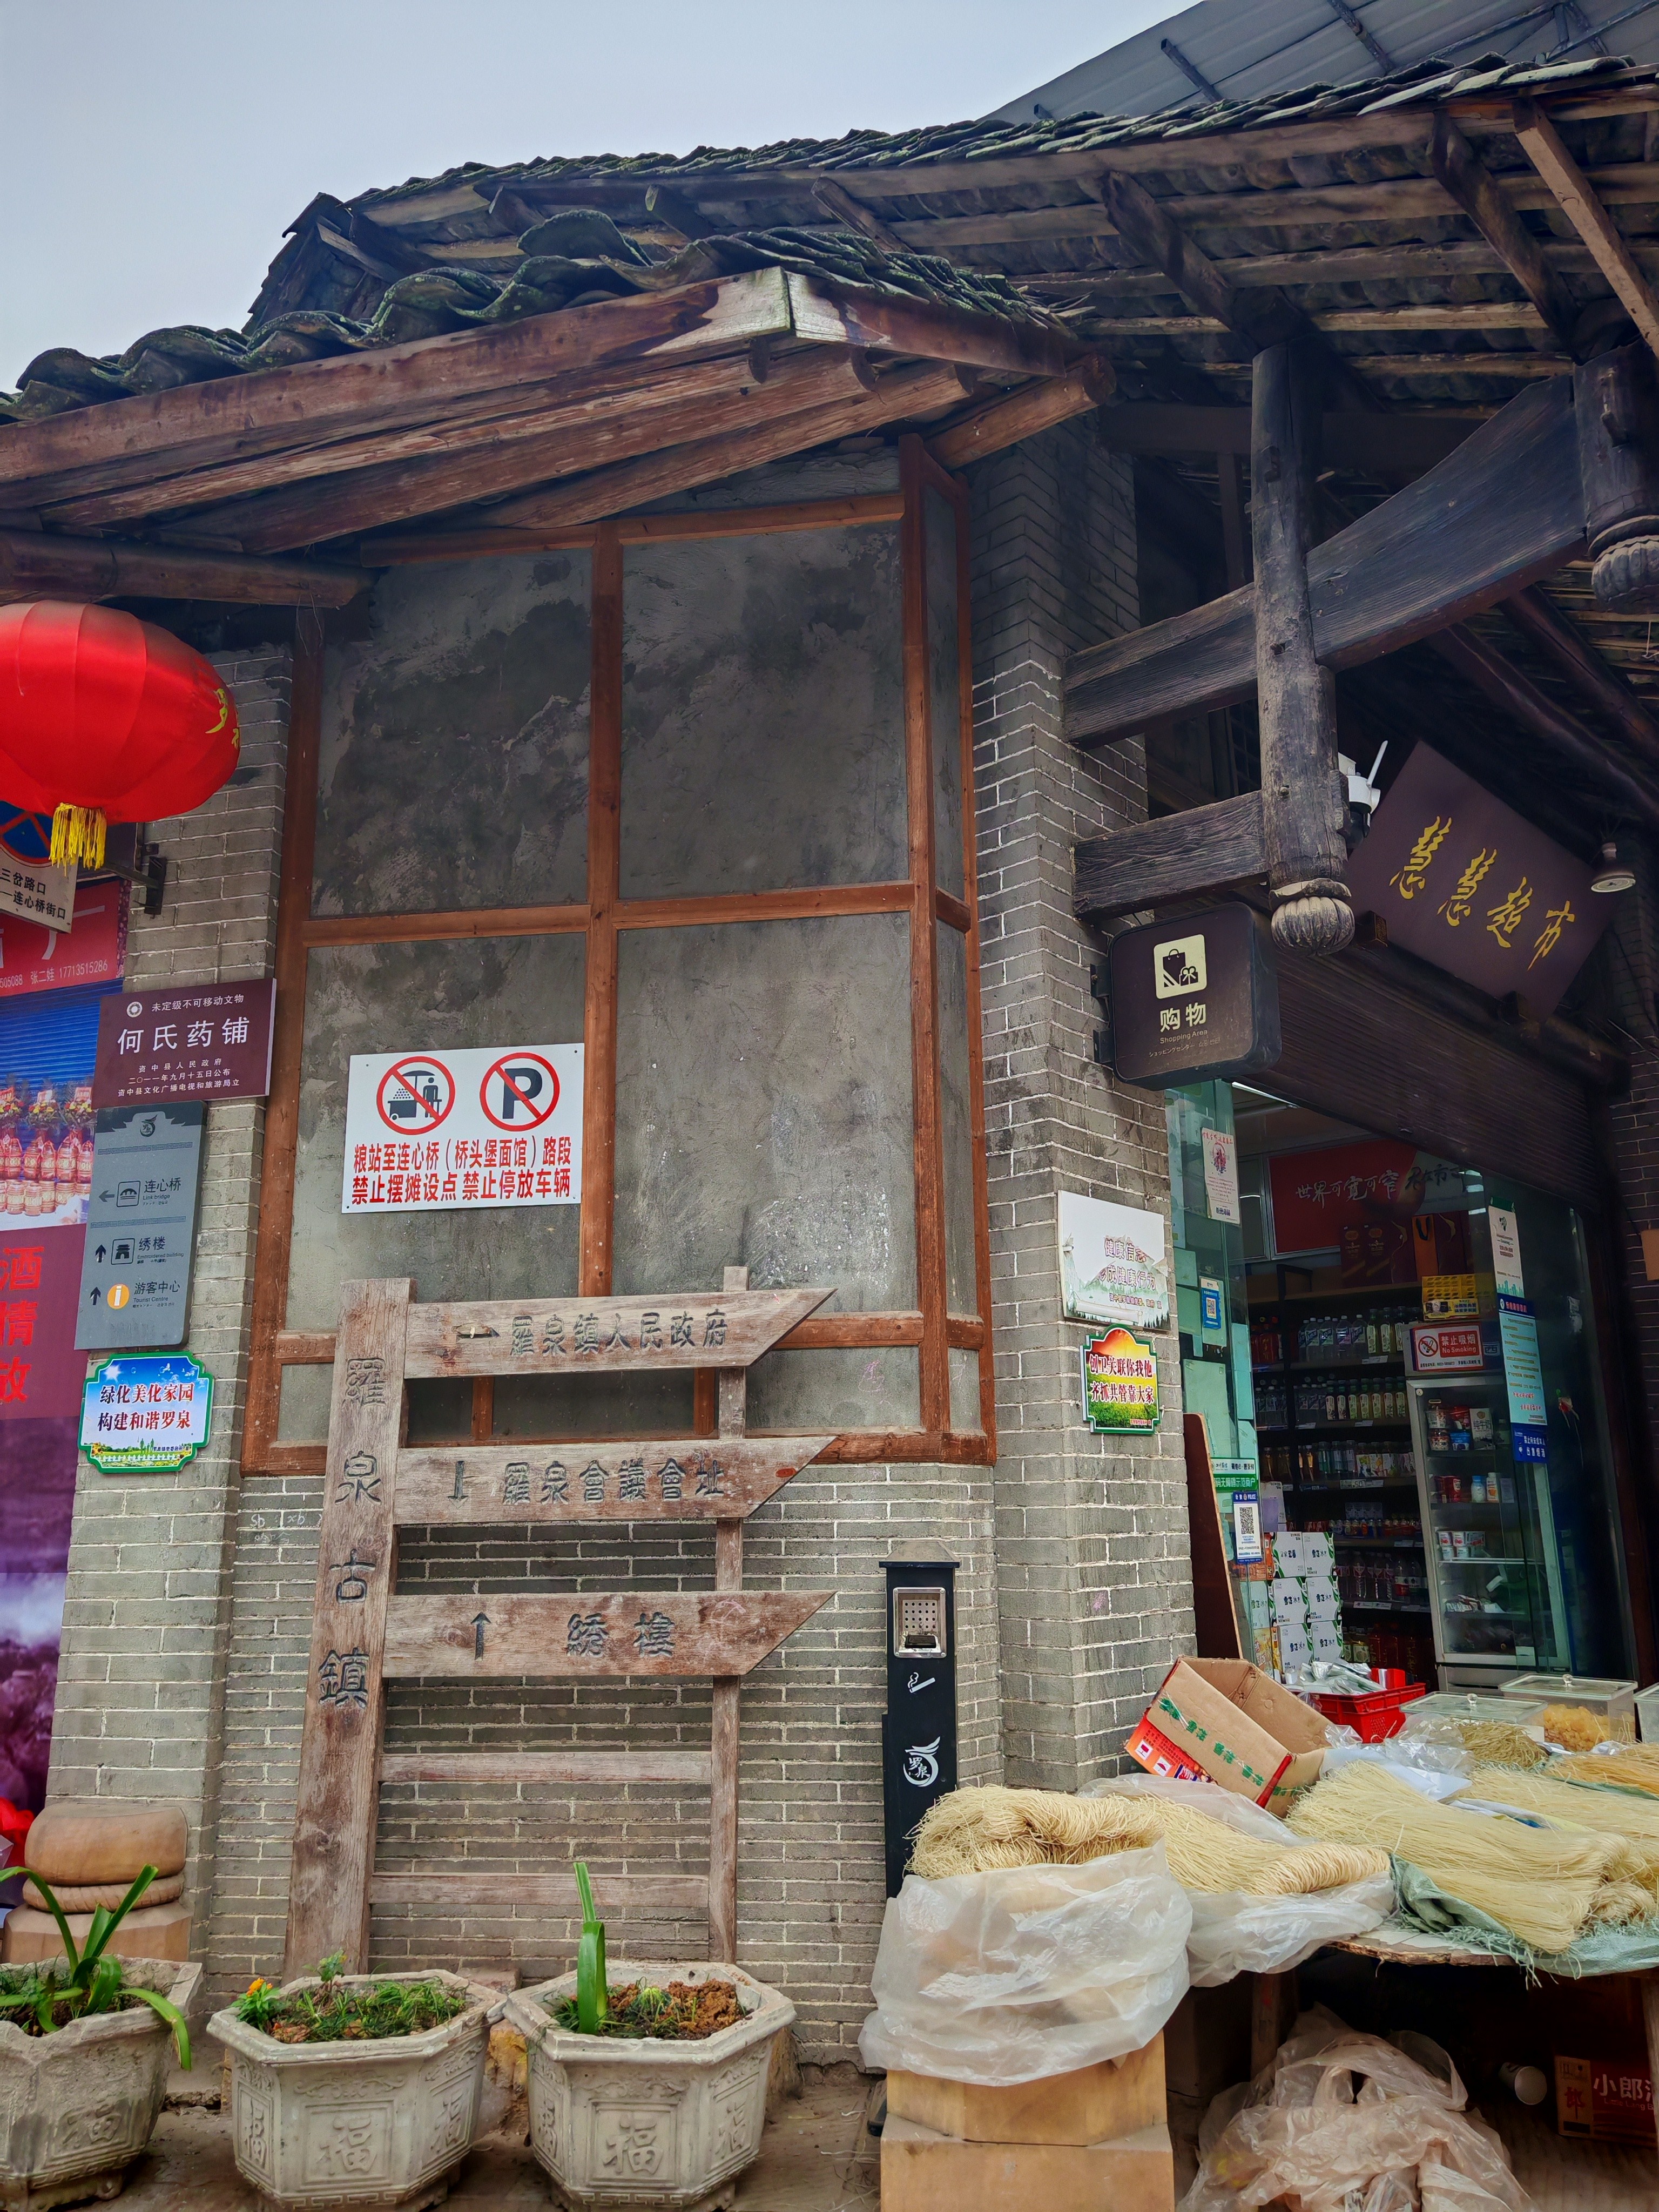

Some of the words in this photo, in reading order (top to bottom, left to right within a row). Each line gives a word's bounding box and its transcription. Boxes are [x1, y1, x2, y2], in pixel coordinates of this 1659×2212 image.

[151, 994, 244, 1012] 未定级不可移动文物
[1160, 1002, 1206, 1033] 购物
[117, 1016, 249, 1055] 何氏药铺
[1160, 1033, 1191, 1044] Shopping
[1192, 1029, 1208, 1037] Area
[138, 1057, 222, 1073] 资中县人民政府
[118, 1078, 240, 1097] 资中县文化广播电视和旅游局立
[144, 1177, 181, 1193] 连心桥
[352, 1172, 457, 1205] 禁止摆摊设点
[462, 1168, 571, 1201] 禁止停放车辆
[138, 1235, 166, 1251] 绣楼
[133, 1280, 180, 1295] 游客中心
[1090, 1354, 1152, 1378] 创卫关联你我他
[99, 1383, 194, 1404] 绿化美化家园
[1091, 1381, 1155, 1404] 齐抓共管靠大家
[97, 1410, 191, 1432] 构建和谐罗泉
